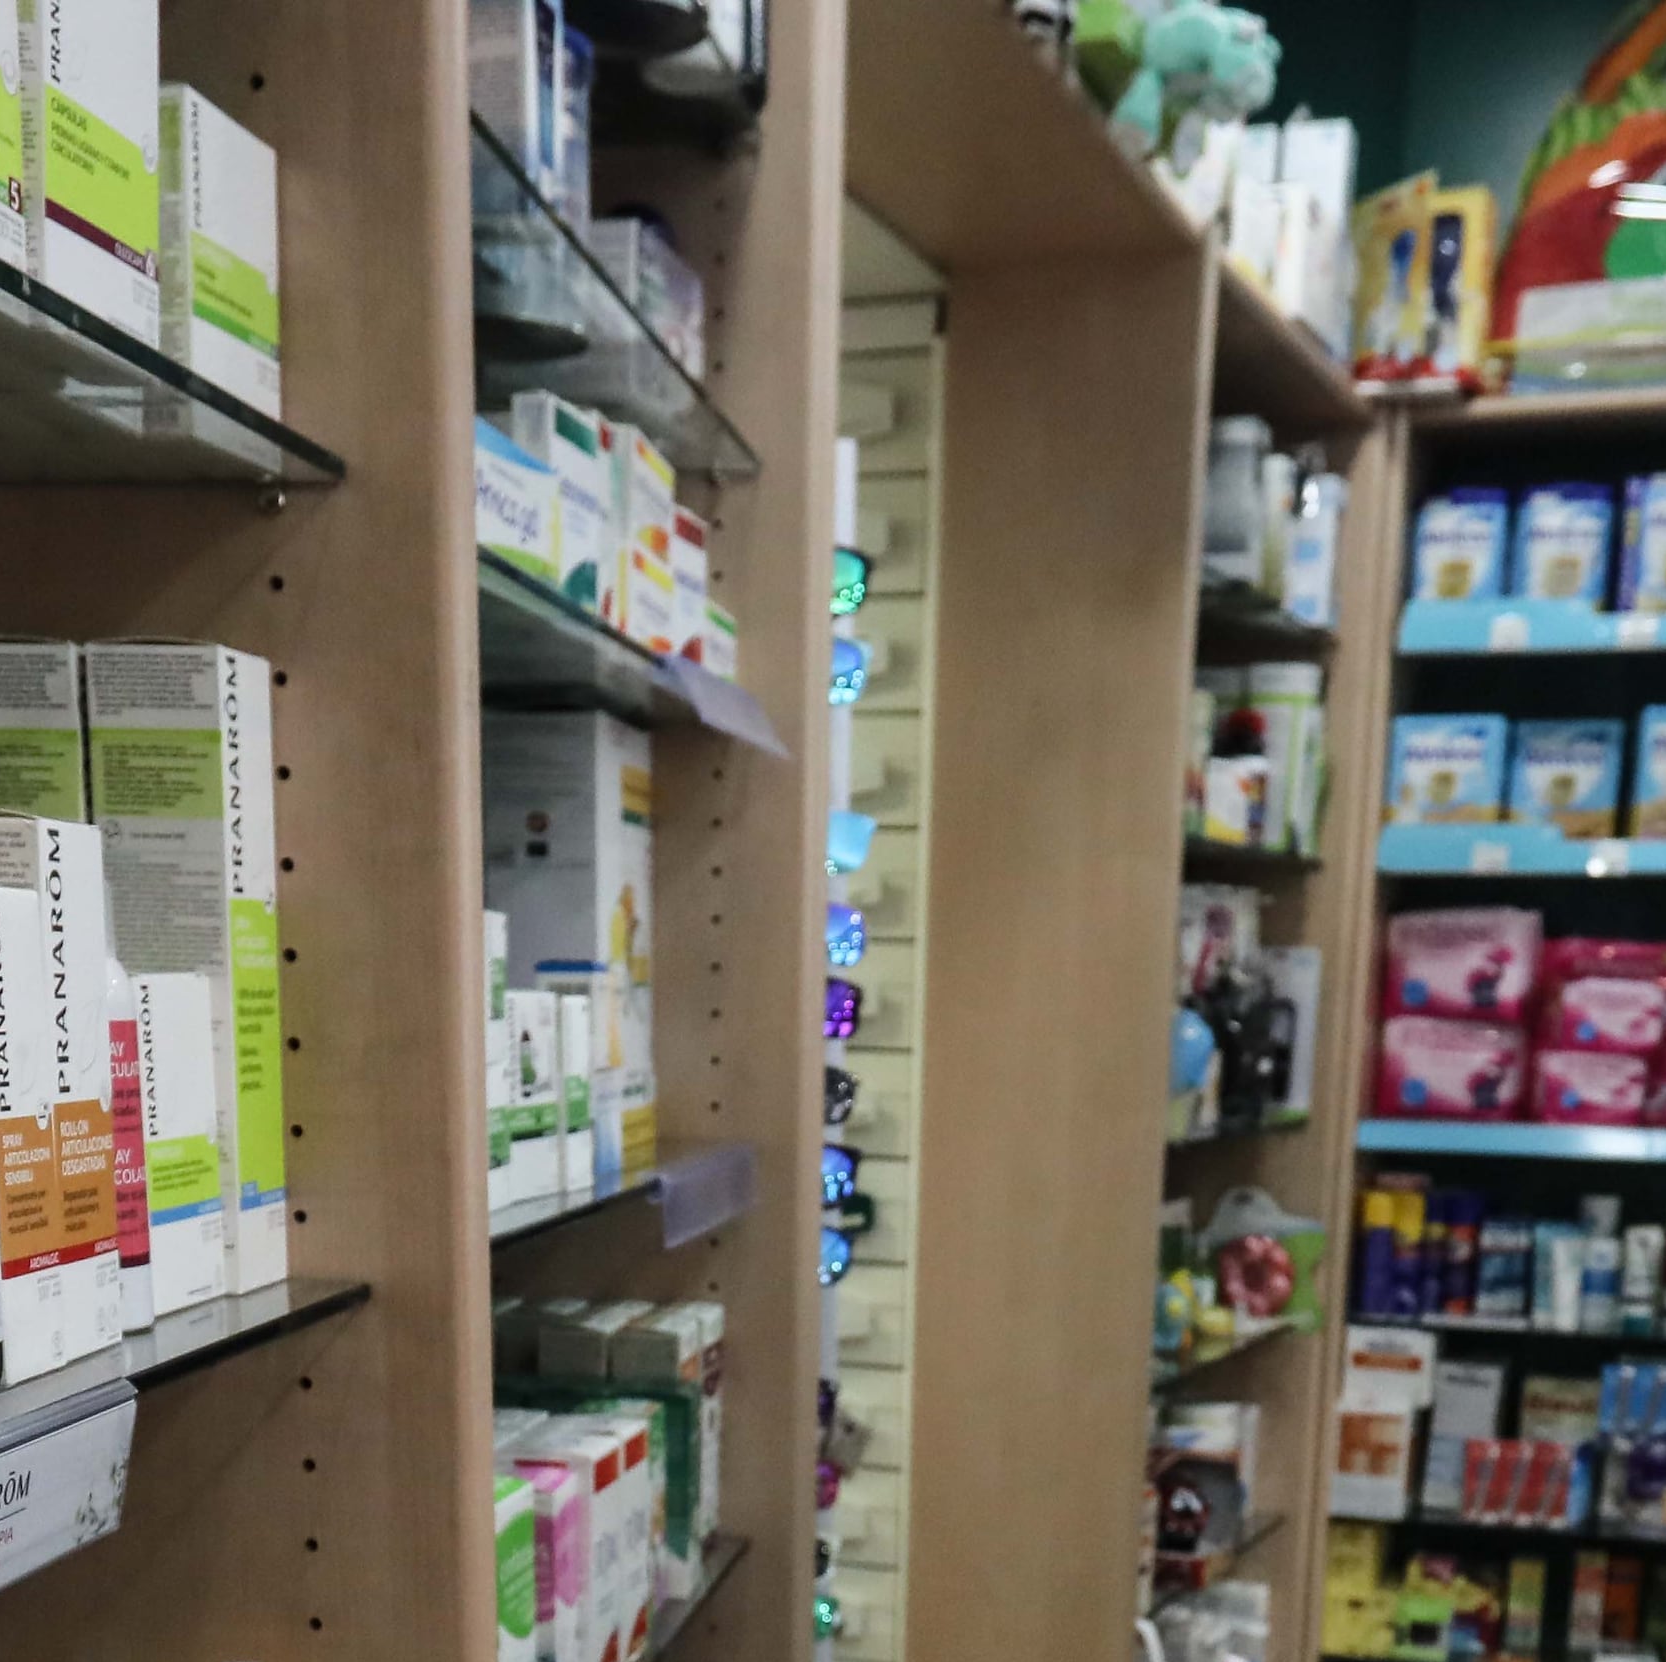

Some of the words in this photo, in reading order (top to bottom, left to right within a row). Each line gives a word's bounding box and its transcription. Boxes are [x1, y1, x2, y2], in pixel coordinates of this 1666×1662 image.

[9, 182, 20, 212] 5
[44, 827, 71, 1095] PRANARŌM
[140, 984, 159, 1137] PRANARŌM
